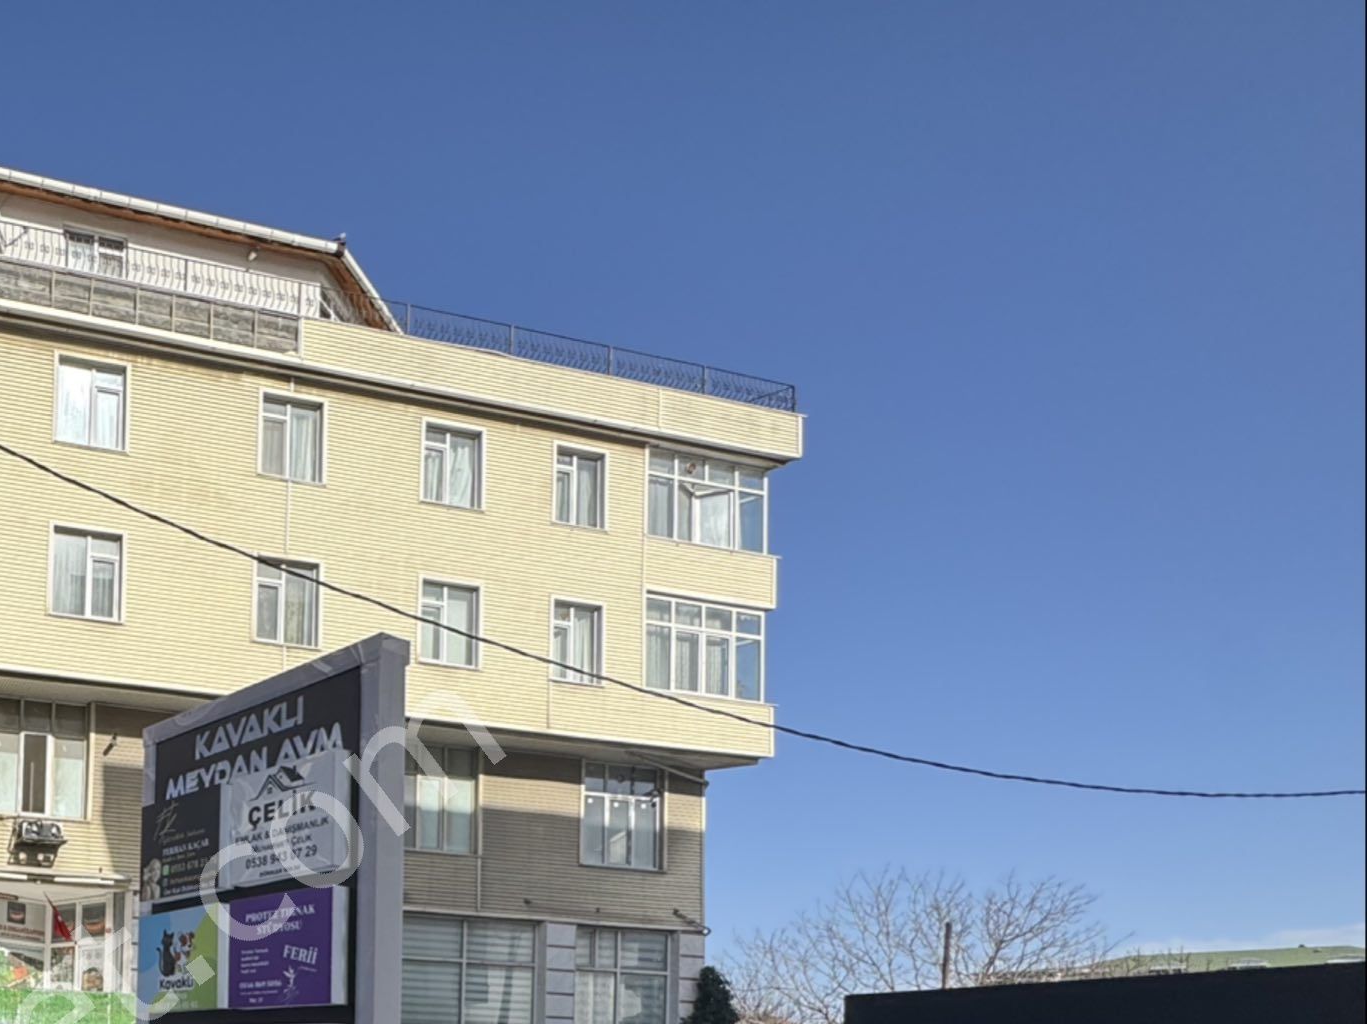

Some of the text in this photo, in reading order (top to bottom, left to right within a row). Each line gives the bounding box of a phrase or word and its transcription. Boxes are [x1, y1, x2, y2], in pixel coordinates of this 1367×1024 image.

[194, 695, 305, 760] KAVAKLI
[165, 721, 344, 800] MEYDAN AVM
[247, 790, 317, 831] ÇELİK
